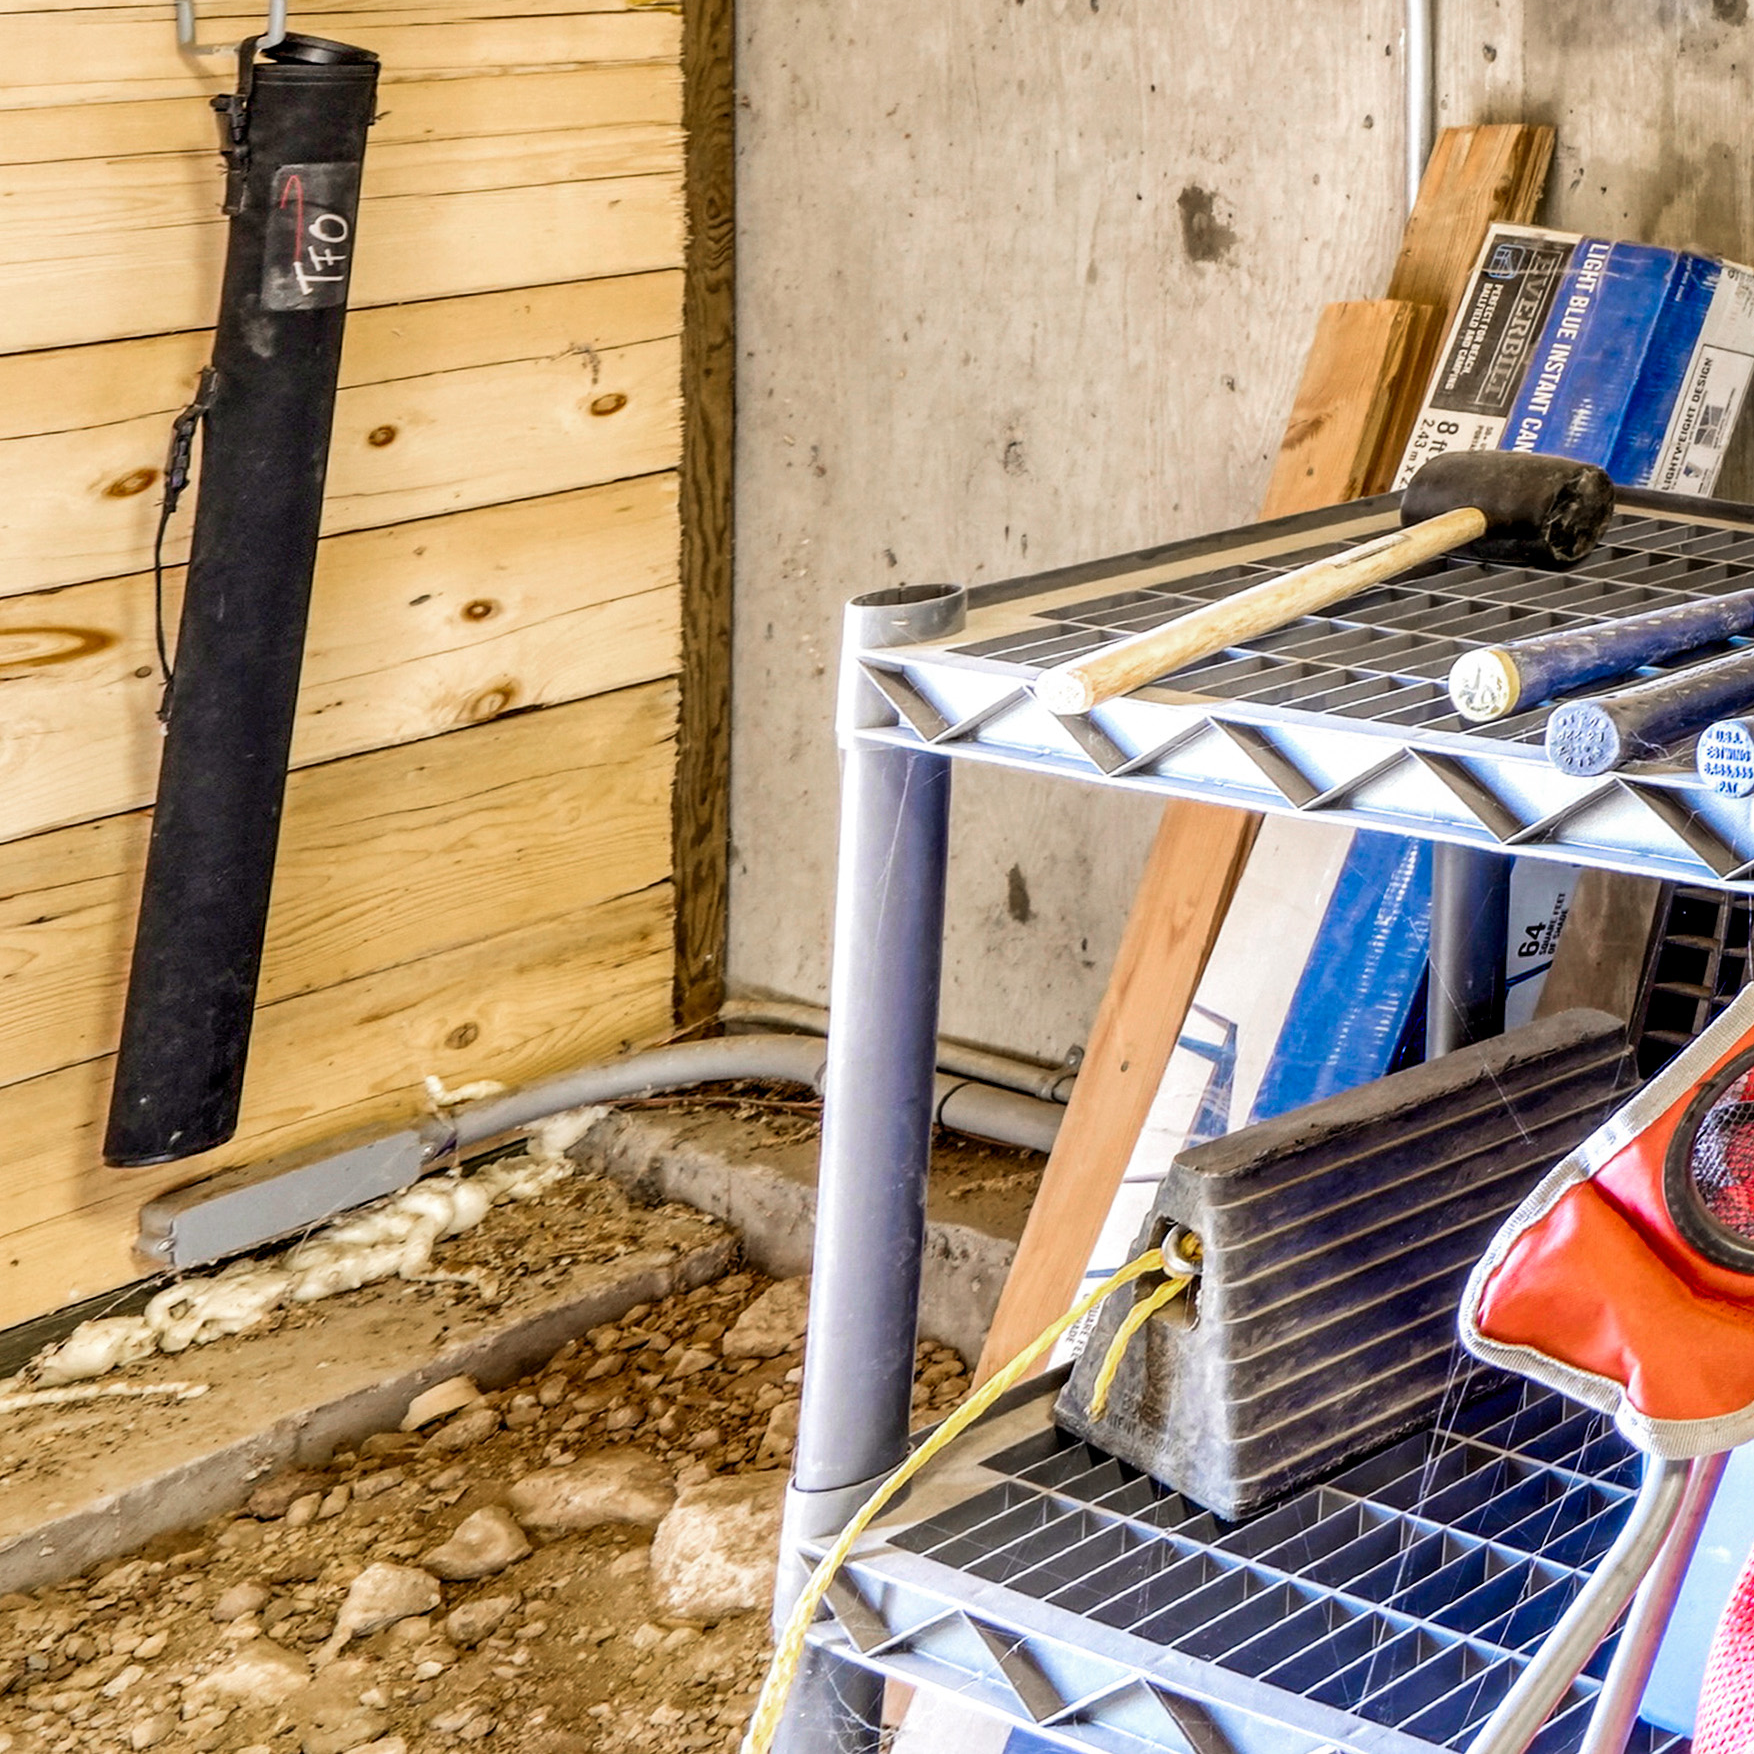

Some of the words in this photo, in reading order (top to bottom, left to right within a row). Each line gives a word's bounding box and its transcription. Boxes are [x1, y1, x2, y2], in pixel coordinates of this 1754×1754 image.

[1575, 243, 1610, 293] LIGHT
[1469, 283, 1493, 329] BALLFIELD
[1481, 284, 1504, 323] PERFECT
[1556, 296, 1590, 340] BLUE
[1461, 329, 1475, 347] AND
[1474, 324, 1488, 343] FOR
[1485, 255, 1557, 399] EVERBILT
[1445, 349, 1467, 390] CAMPING
[1527, 343, 1572, 416] INSTANT
[1692, 357, 1713, 403] DESIGN
[1414, 418, 1436, 449] 2.43
[1428, 439, 1448, 453] ft
[1437, 421, 1459, 435] 8
[1408, 451, 1418, 461] m
[1518, 922, 1547, 957] 64
[1538, 918, 1558, 955] SQUARE
[1553, 893, 1566, 915] FEET
[1547, 943, 1557, 955] OF
[1552, 909, 1569, 939] SHADE
